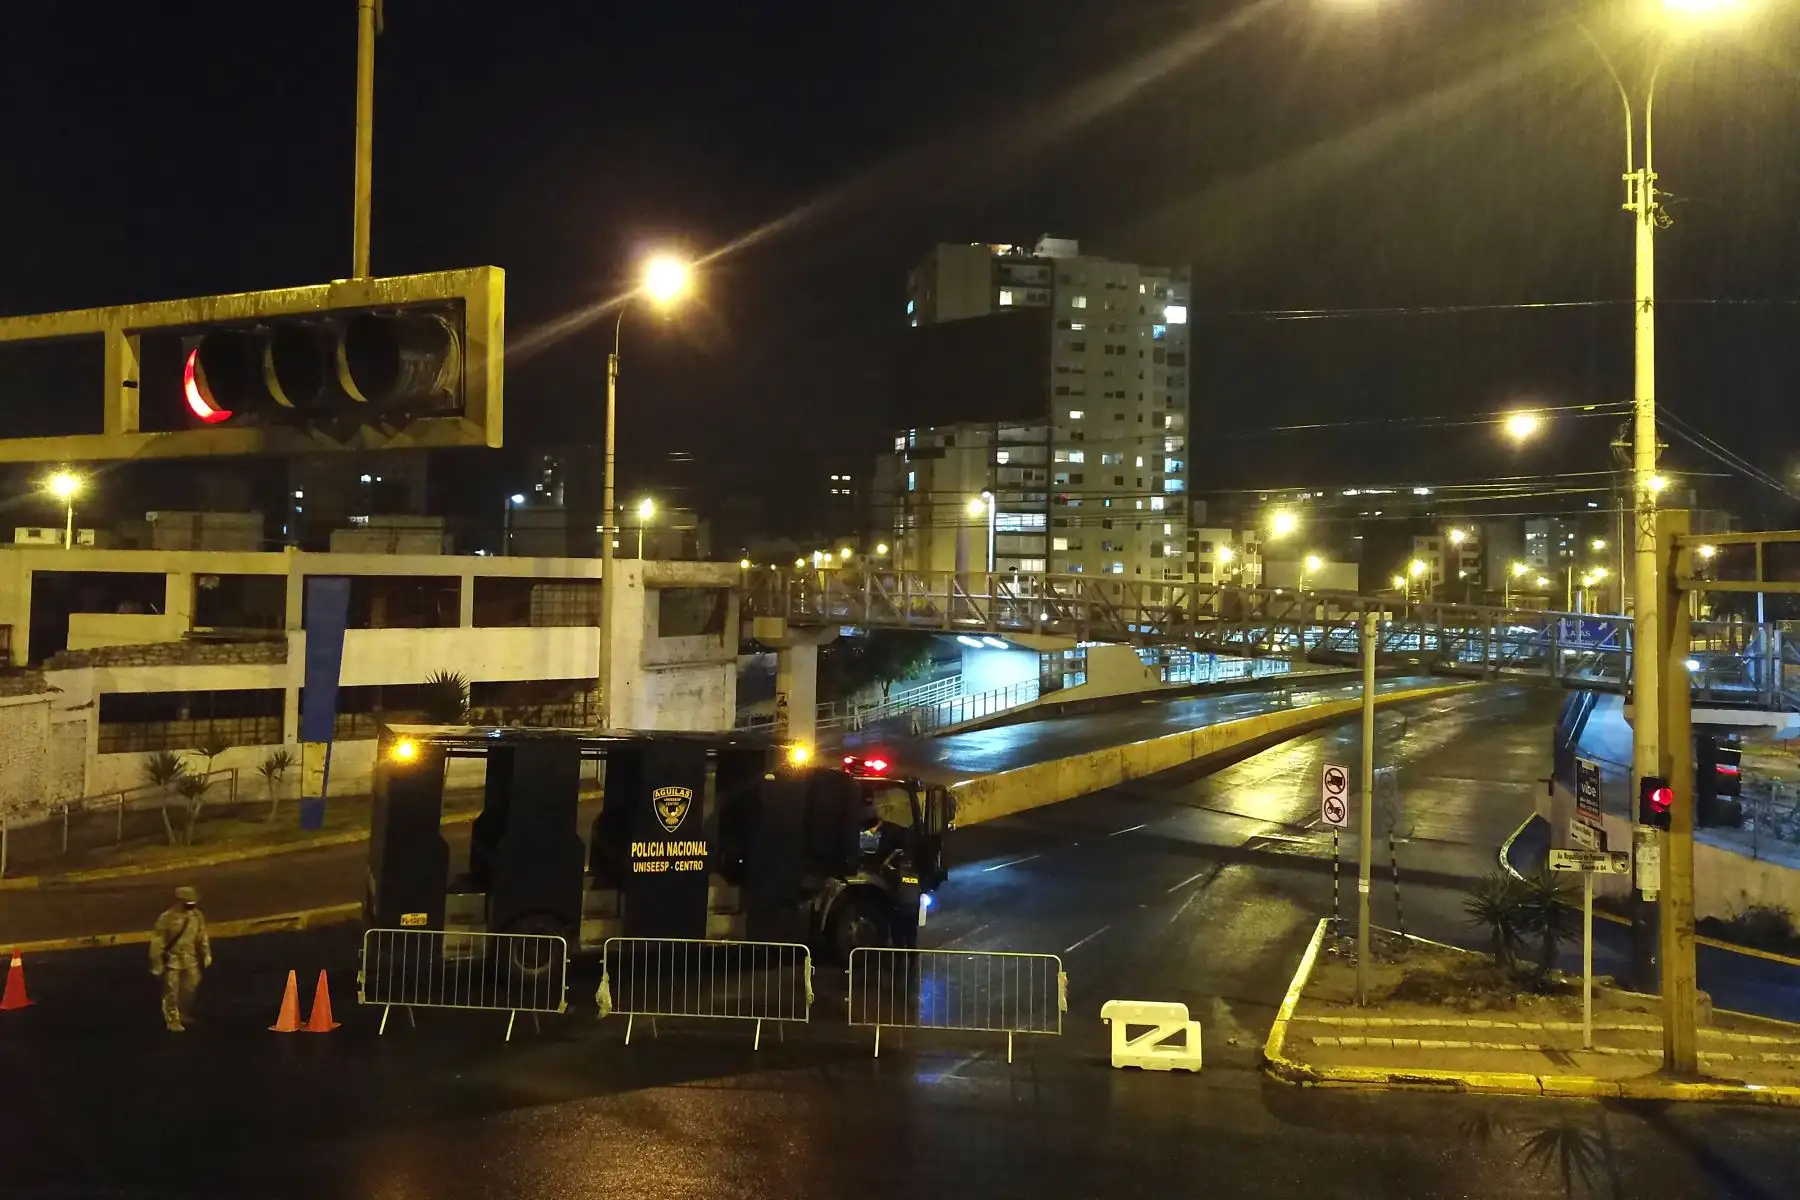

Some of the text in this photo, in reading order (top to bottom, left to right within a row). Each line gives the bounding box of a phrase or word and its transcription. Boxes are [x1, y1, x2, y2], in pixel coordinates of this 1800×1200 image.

[655, 788, 690, 798] AGUILAS
[632, 840, 708, 857] POLICIA NACIONAL
[633, 861, 669, 872] UNISEESP
[675, 860, 703, 871] CENTRO
